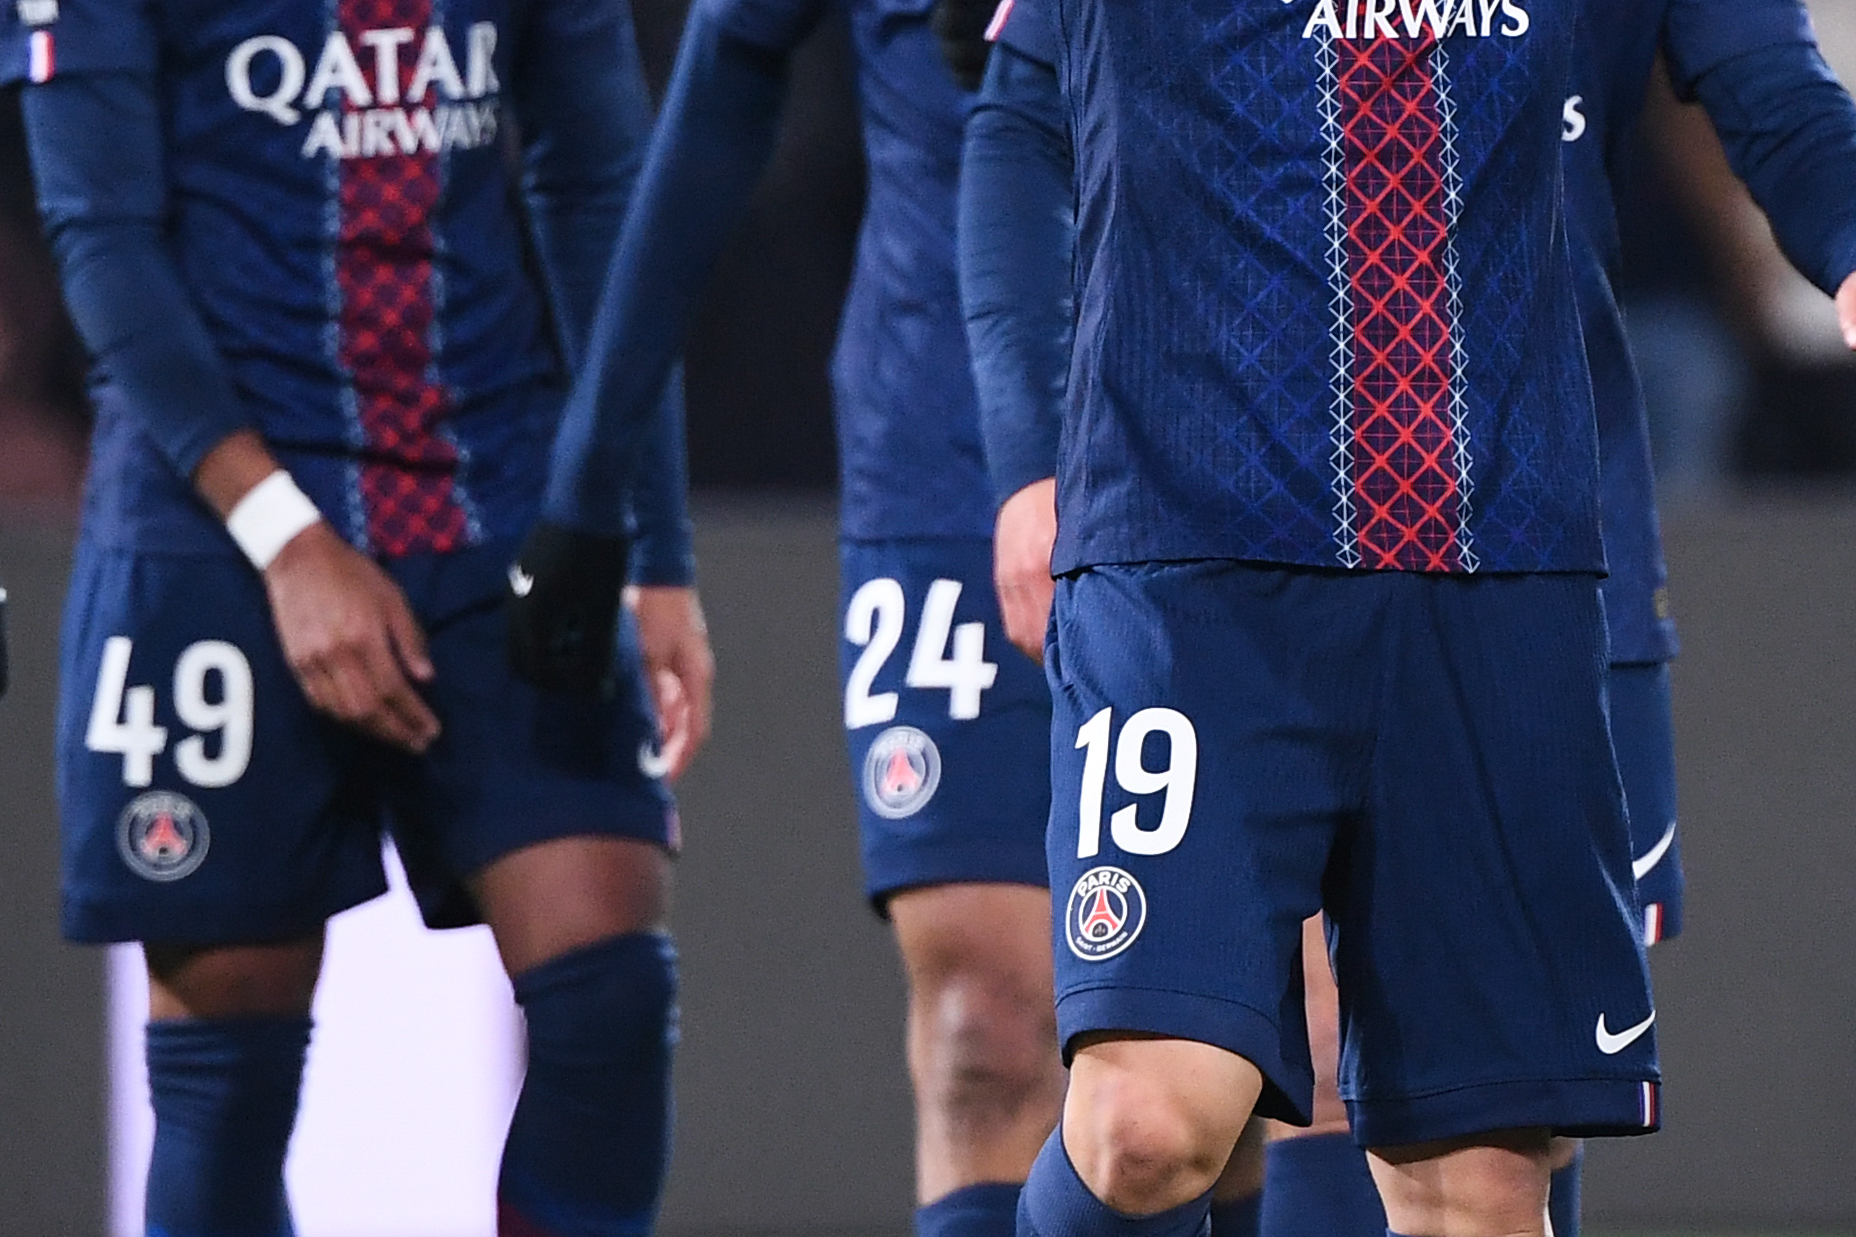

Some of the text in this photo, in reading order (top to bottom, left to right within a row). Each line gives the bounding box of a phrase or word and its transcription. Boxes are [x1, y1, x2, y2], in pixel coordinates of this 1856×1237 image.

[225, 21, 499, 126] QATAR
[84, 635, 254, 788] 49
[844, 577, 998, 730] 24
[1074, 706, 1198, 859] 19
[1077, 871, 1131, 897] PARIS
